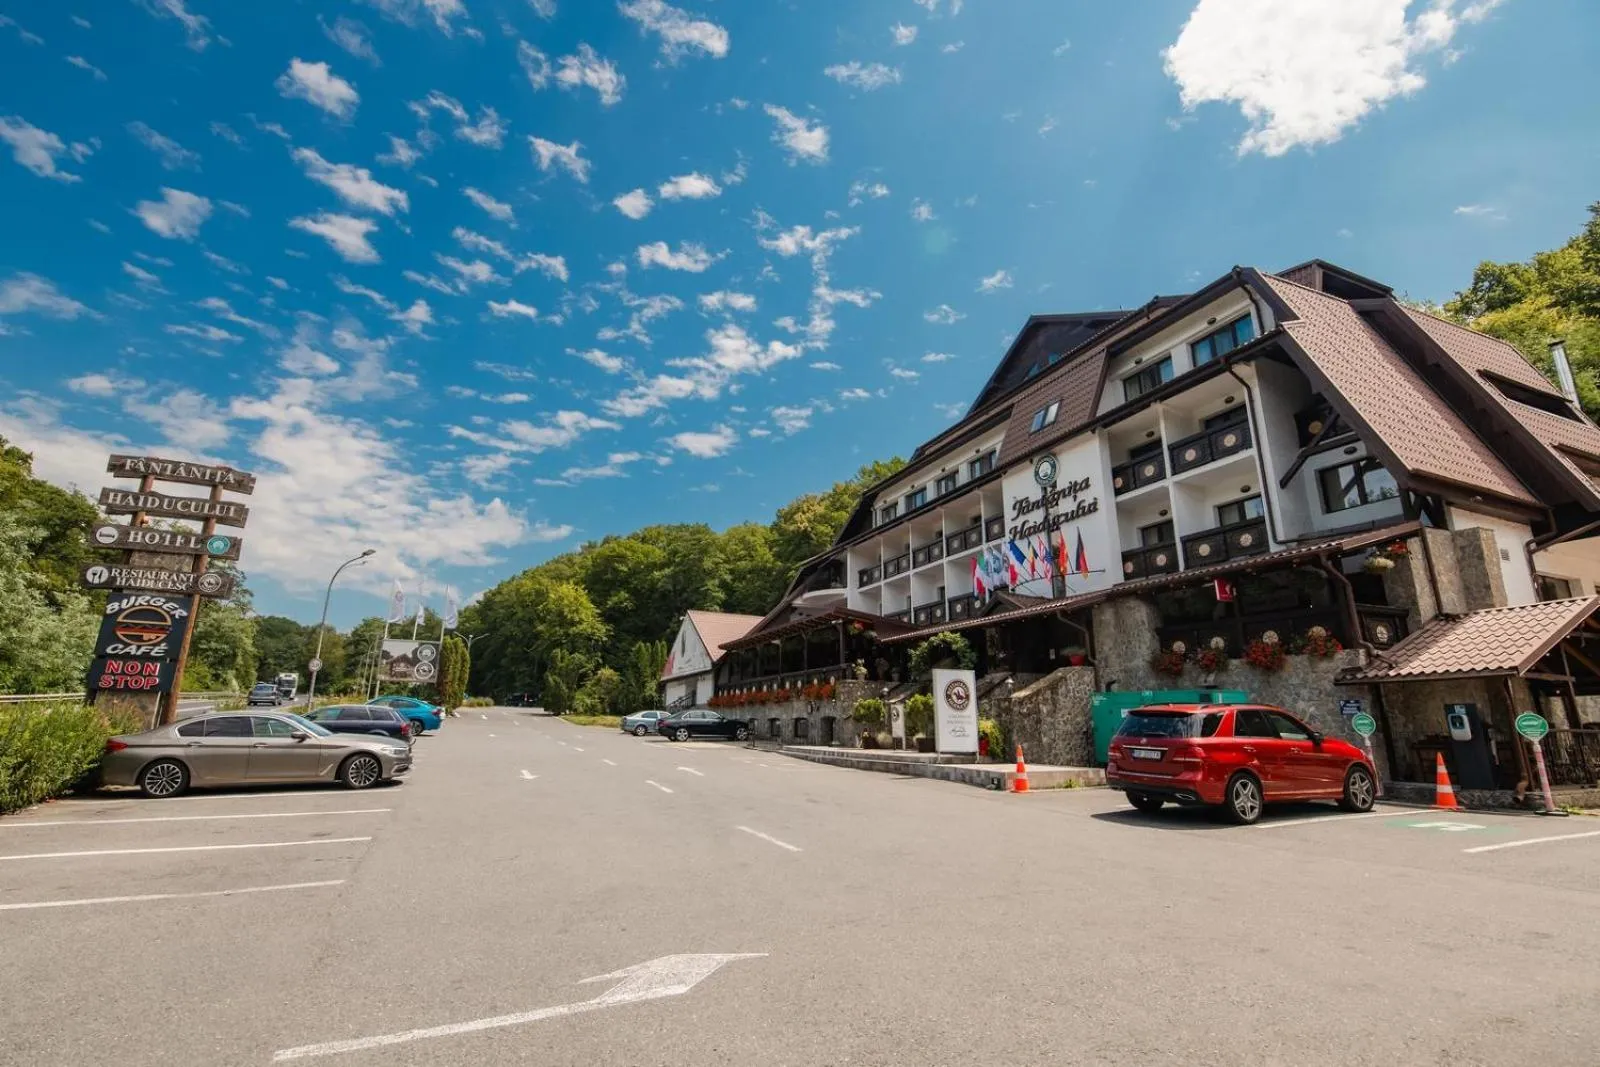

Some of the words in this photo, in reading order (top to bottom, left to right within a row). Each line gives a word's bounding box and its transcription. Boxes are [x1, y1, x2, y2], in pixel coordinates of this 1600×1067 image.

[107, 492, 234, 517] HAIDUCULUI
[126, 531, 201, 549] HOTEL
[111, 568, 197, 583] RESTAURANT
[116, 577, 192, 591] HAIDUCESC
[105, 595, 188, 619] BURGER
[105, 643, 168, 656] CAFÉ
[105, 659, 160, 676] NON
[99, 674, 159, 689] STOP
